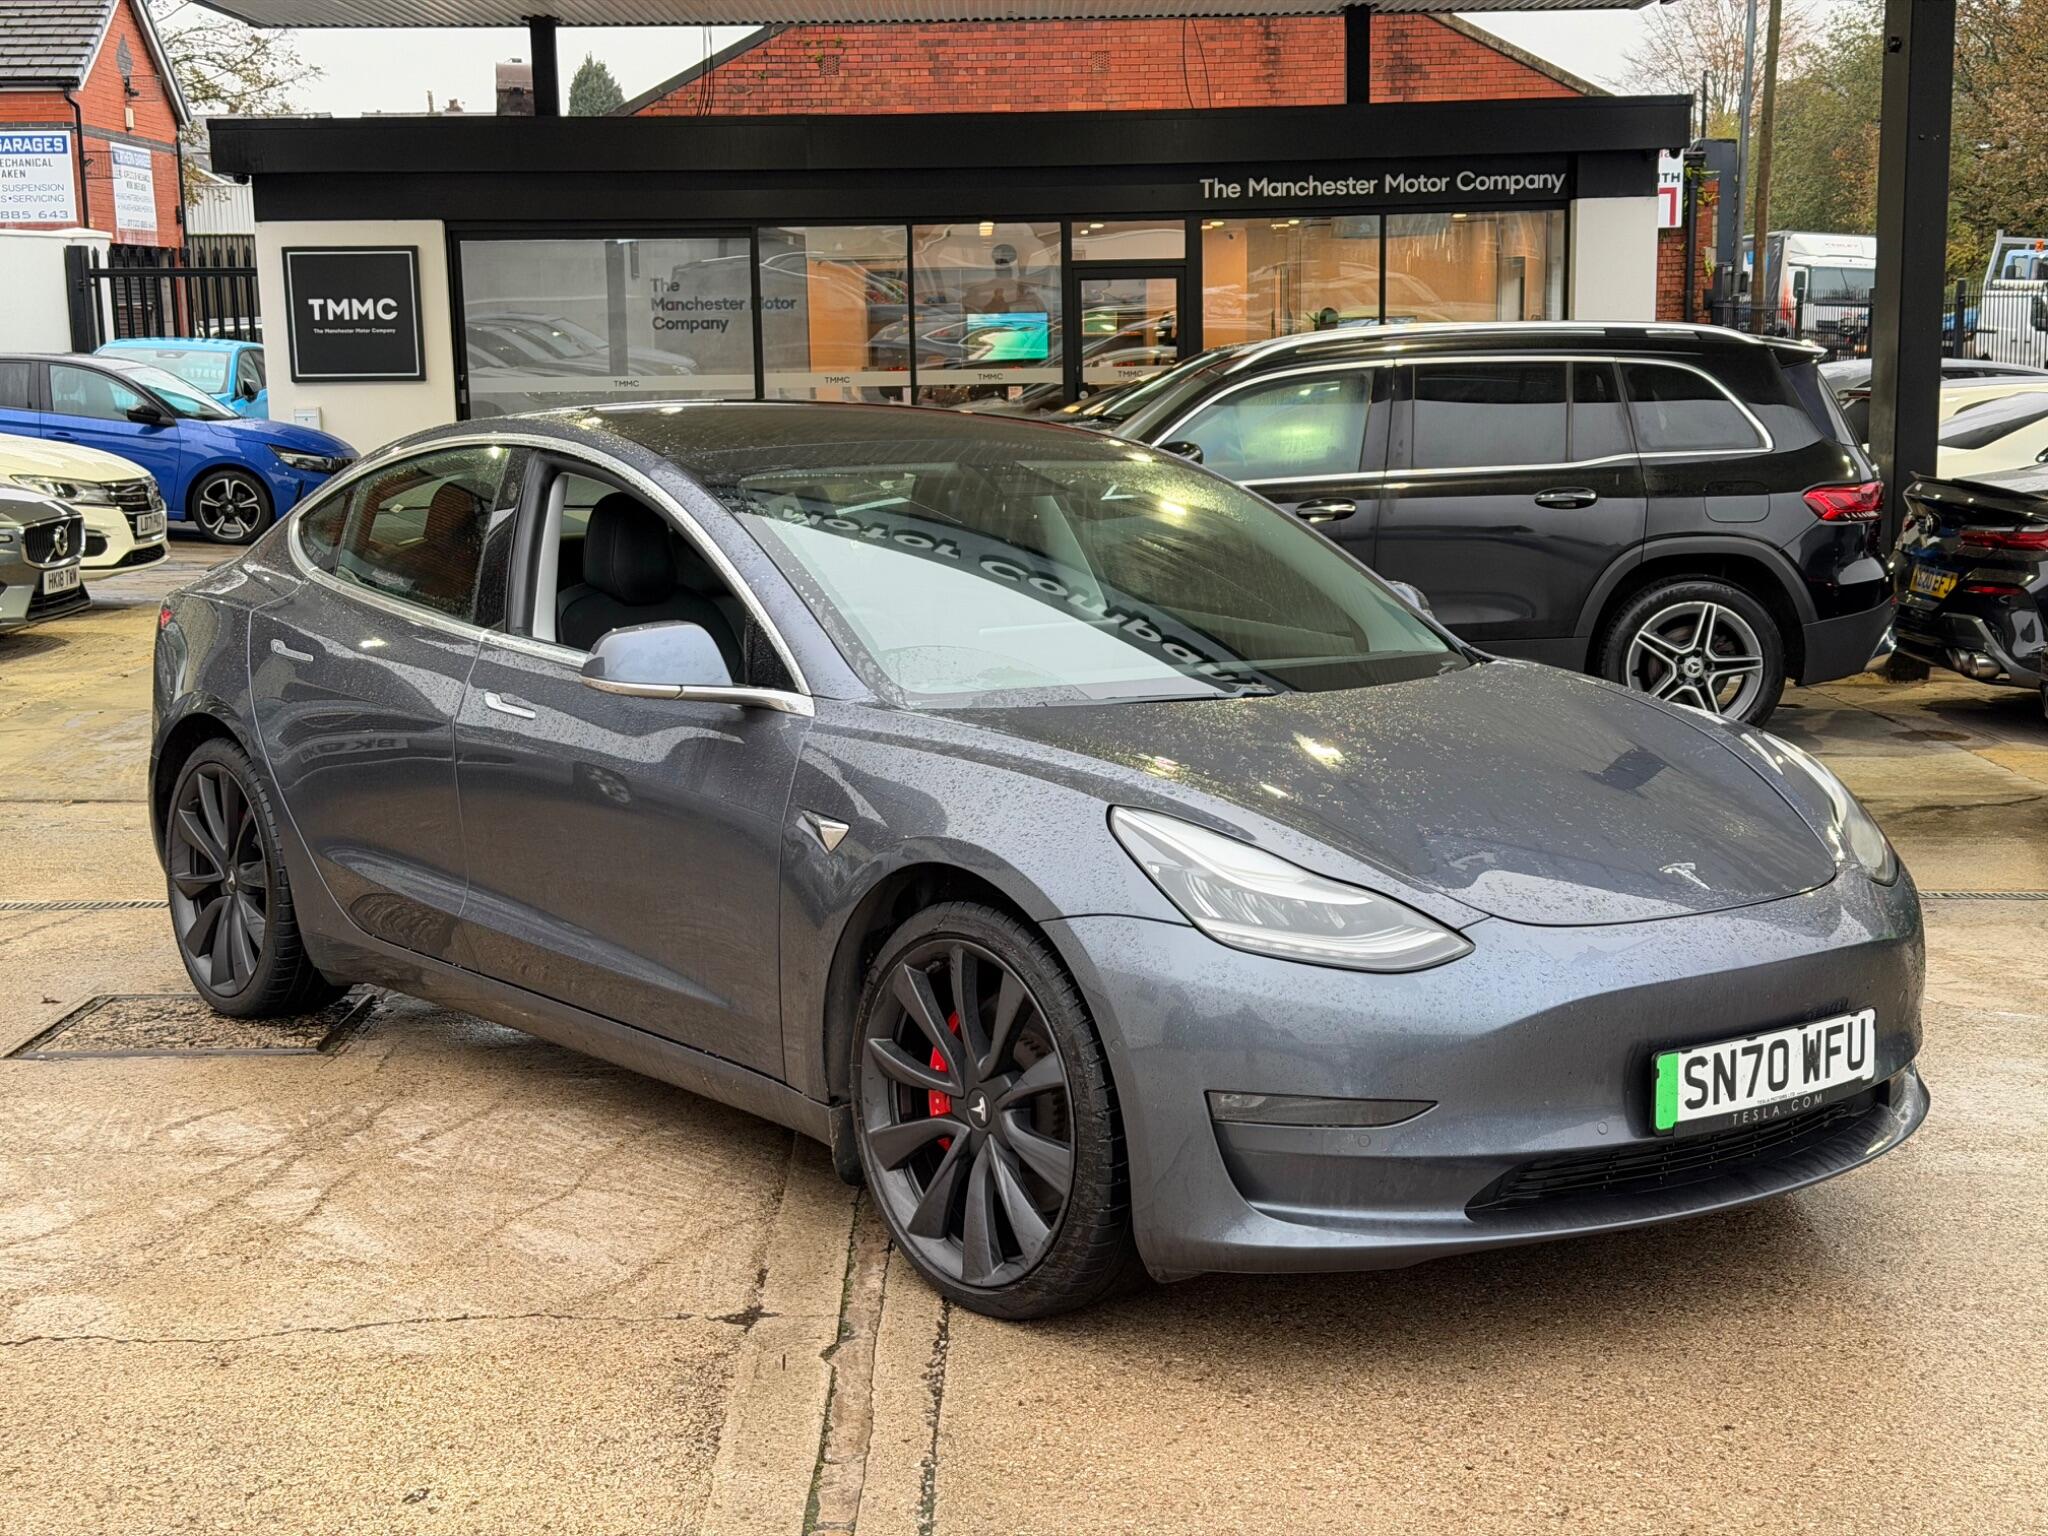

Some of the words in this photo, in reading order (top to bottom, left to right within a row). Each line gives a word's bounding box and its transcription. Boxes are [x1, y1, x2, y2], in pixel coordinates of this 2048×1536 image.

[0, 138, 64, 152] ARAGES
[2, 183, 65, 192] SUSPENSION
[1200, 178, 1241, 199] The
[1248, 175, 1378, 198] Manchester
[1384, 173, 1450, 194] Motor
[1456, 170, 1566, 195] Company
[0, 210, 31, 220] 885
[38, 210, 69, 220] 643
[650, 278, 680, 293] The
[307, 297, 398, 321] TMMC
[651, 296, 745, 311] Manchester
[751, 297, 797, 310] otor
[652, 316, 729, 333] Company
[825, 376, 850, 384] TMMC
[1118, 370, 1143, 378] TMMC
[614, 380, 639, 388] TMMC
[1684, 1039, 1789, 1110] SN70
[1803, 1017, 1866, 1084] WFU
[1733, 1094, 1823, 1125] TESLA.COM
